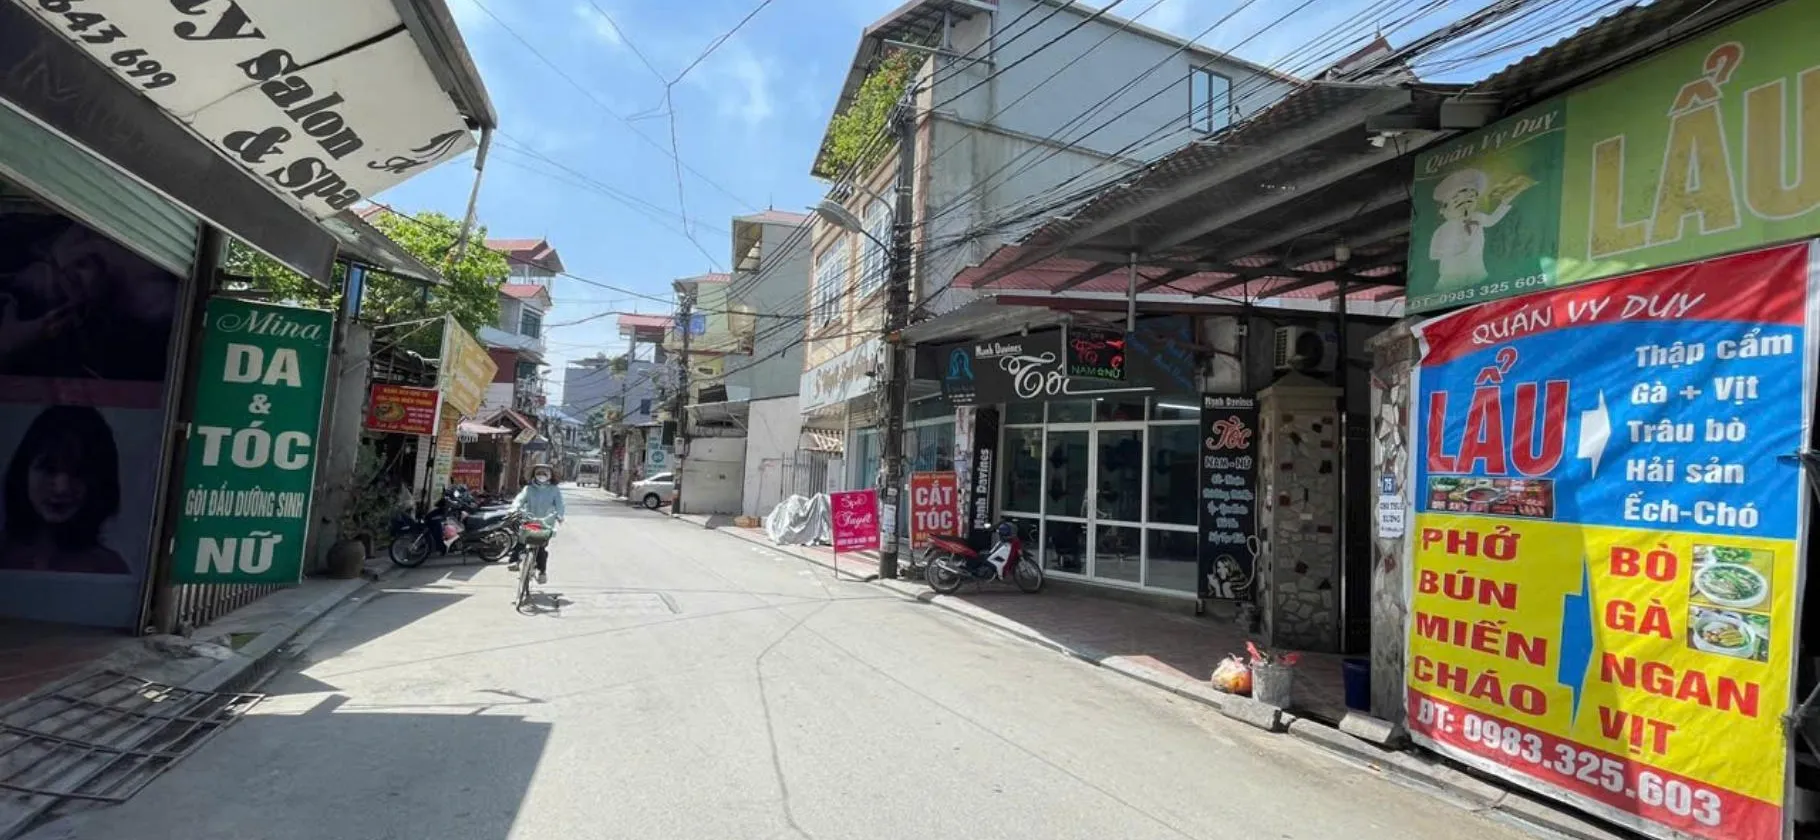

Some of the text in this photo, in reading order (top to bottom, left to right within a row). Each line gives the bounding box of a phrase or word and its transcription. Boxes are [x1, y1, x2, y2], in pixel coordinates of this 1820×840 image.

[110, 49, 176, 89] 699
[235, 49, 364, 161] Salon
[222, 126, 361, 211] & Spa
[1440, 288, 1475, 303] 0983
[1480, 281, 1509, 296] 325
[1514, 273, 1547, 289] 603
[216, 310, 322, 341] Mina
[1472, 293, 1706, 344] QUÁN VY DUY
[223, 343, 302, 387] DA
[1635, 327, 1793, 368] Thập cẩm
[248, 394, 272, 414] &
[1631, 375, 1759, 405] Gà + Vịt
[1427, 346, 1570, 477] LẨU
[1627, 417, 1746, 443] Trâu bò
[197, 421, 311, 470] TÓC
[1204, 456, 1229, 469] NAM
[976, 448, 989, 494] Davines
[1626, 456, 1744, 484] Hải sản
[276, 491, 304, 518] SINH
[915, 507, 953, 530] TÓC
[1624, 491, 1759, 528] Ếch-Chó
[195, 531, 283, 574] NỮ
[1422, 525, 1521, 562] PHỞ
[1610, 543, 1678, 582] BÒ
[1418, 569, 1519, 611] BÚN
[1416, 611, 1549, 668] MIẾN
[1605, 599, 1673, 640] GÀ
[1413, 655, 1548, 716] CHÁO
[1600, 651, 1760, 719] NGAN
[1598, 705, 1676, 756] VỊT
[1463, 714, 1721, 827] 0983.325.603
